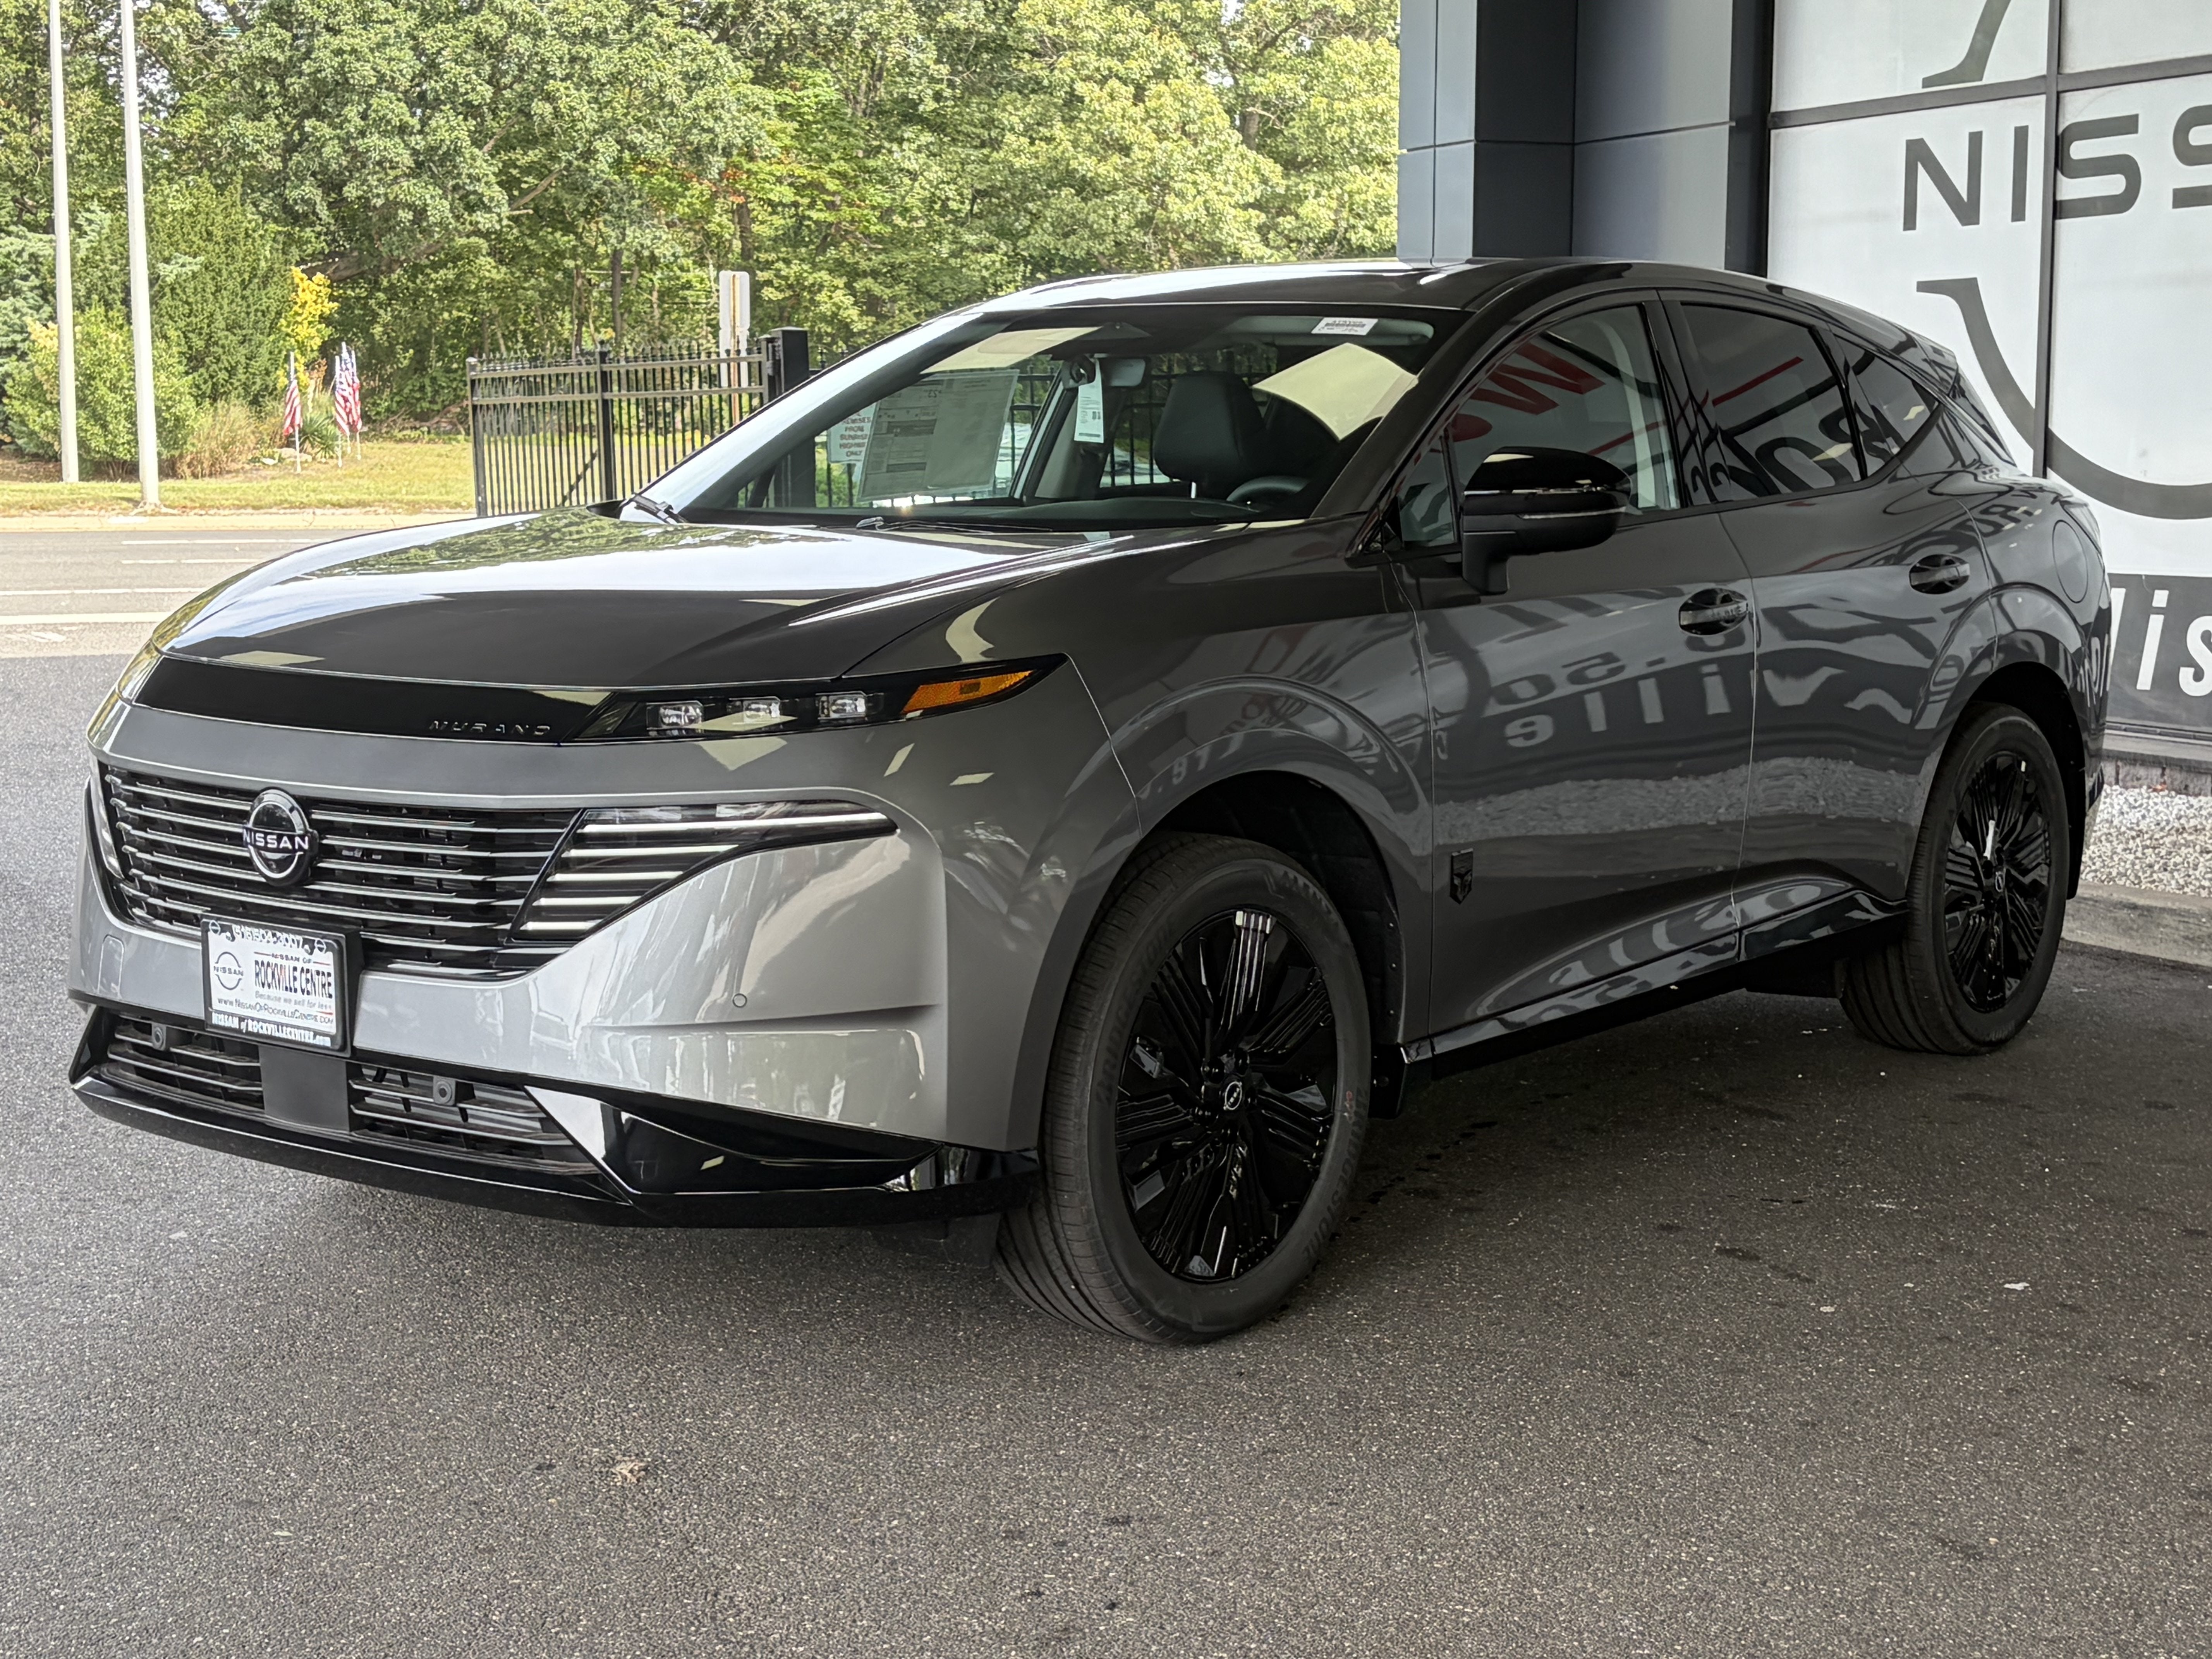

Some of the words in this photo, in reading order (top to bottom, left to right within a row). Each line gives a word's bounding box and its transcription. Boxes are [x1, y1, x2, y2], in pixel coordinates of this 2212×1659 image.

[243, 828, 309, 850] NISSAN
[272, 953, 300, 962] NISSAN
[213, 965, 244, 977] NISSAN
[254, 960, 298, 994] ROCKVILLE
[300, 966, 333, 999] CENTRE
